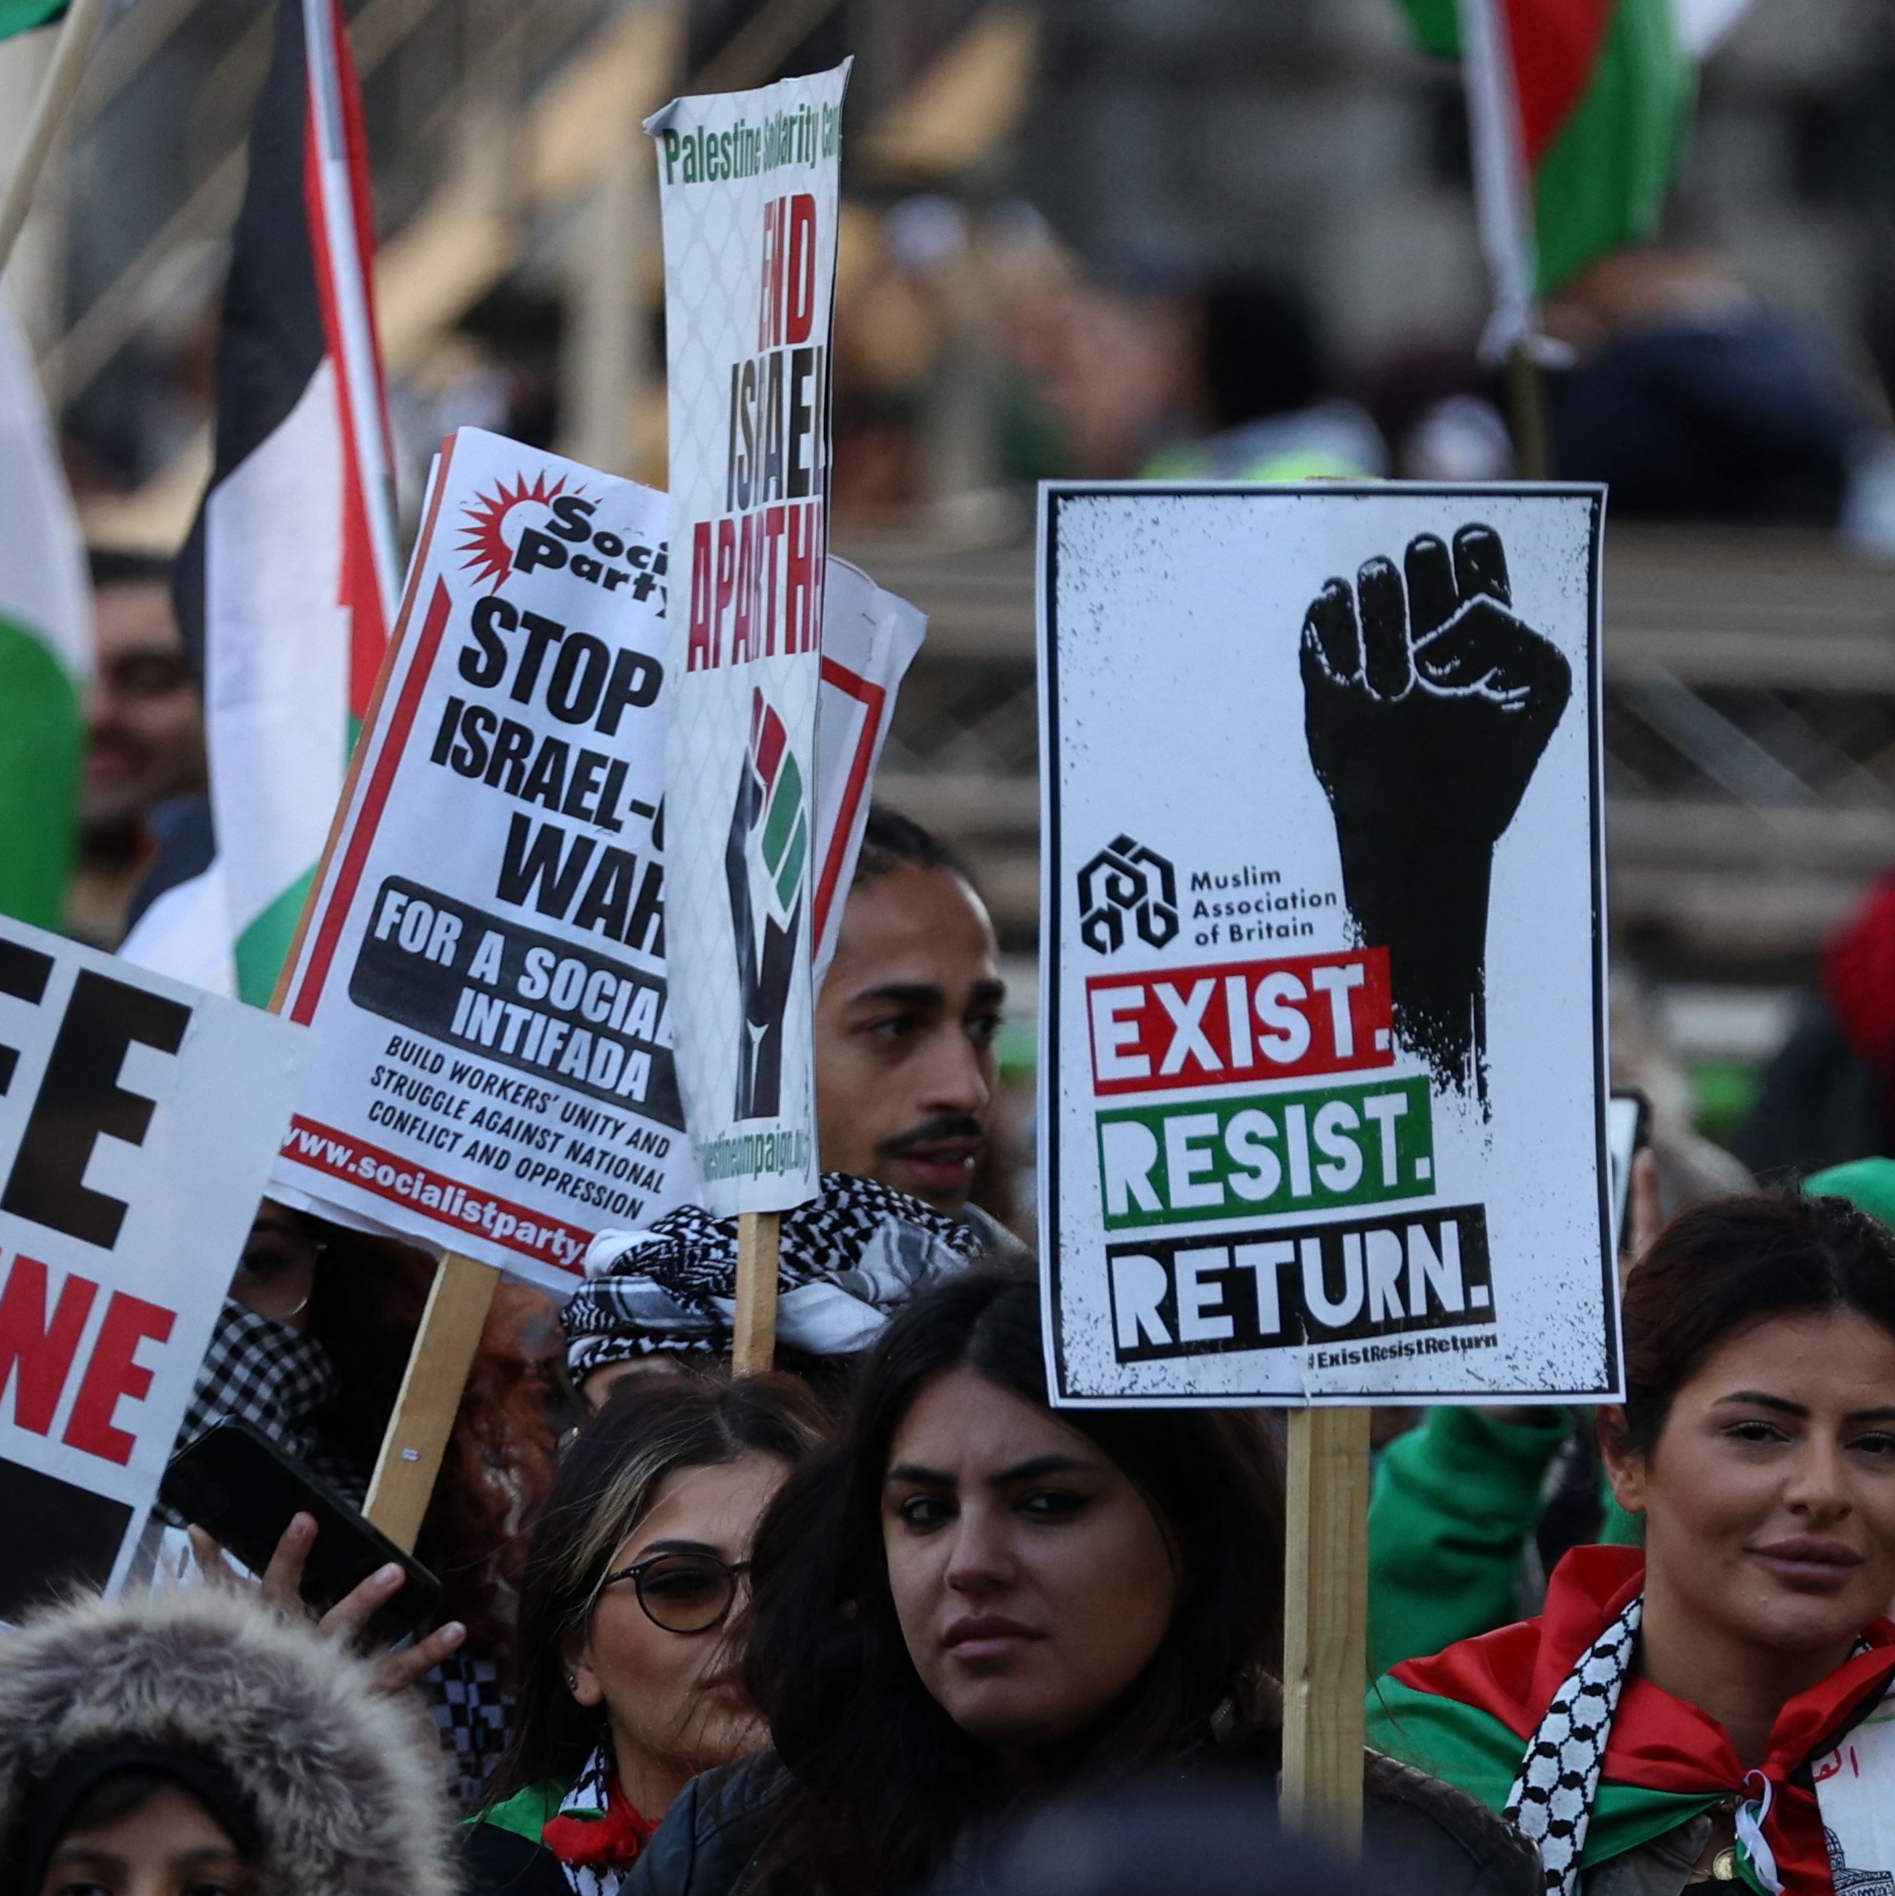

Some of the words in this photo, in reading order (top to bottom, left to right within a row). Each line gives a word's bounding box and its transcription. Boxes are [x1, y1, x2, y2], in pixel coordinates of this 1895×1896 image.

[663, 118, 762, 186] Palestine
[458, 595, 665, 737] STOP
[375, 888, 464, 968] FOR
[466, 932, 506, 985] A
[1190, 865, 1282, 892] Muslim
[1192, 888, 1337, 919] Association
[1195, 923, 1220, 947] of
[1229, 916, 1314, 943] Britain
[450, 988, 654, 1103] INTIFADA
[1093, 961, 1392, 1084] EXIST.
[369, 1064, 467, 1121] STRUGGLE
[468, 1106, 564, 1155] AGAINST
[564, 1142, 667, 1195] NATIONAL
[384, 1034, 445, 1075] BUILD
[561, 1102, 628, 1140] UNITY
[625, 1128, 672, 1159] AND
[1100, 1093, 1432, 1220] RESIST.
[367, 1098, 465, 1156] CONFLICT
[463, 1139, 510, 1172] AND
[514, 1156, 645, 1222] OPPRESSION
[1112, 1219, 1489, 1353] RETURN.
